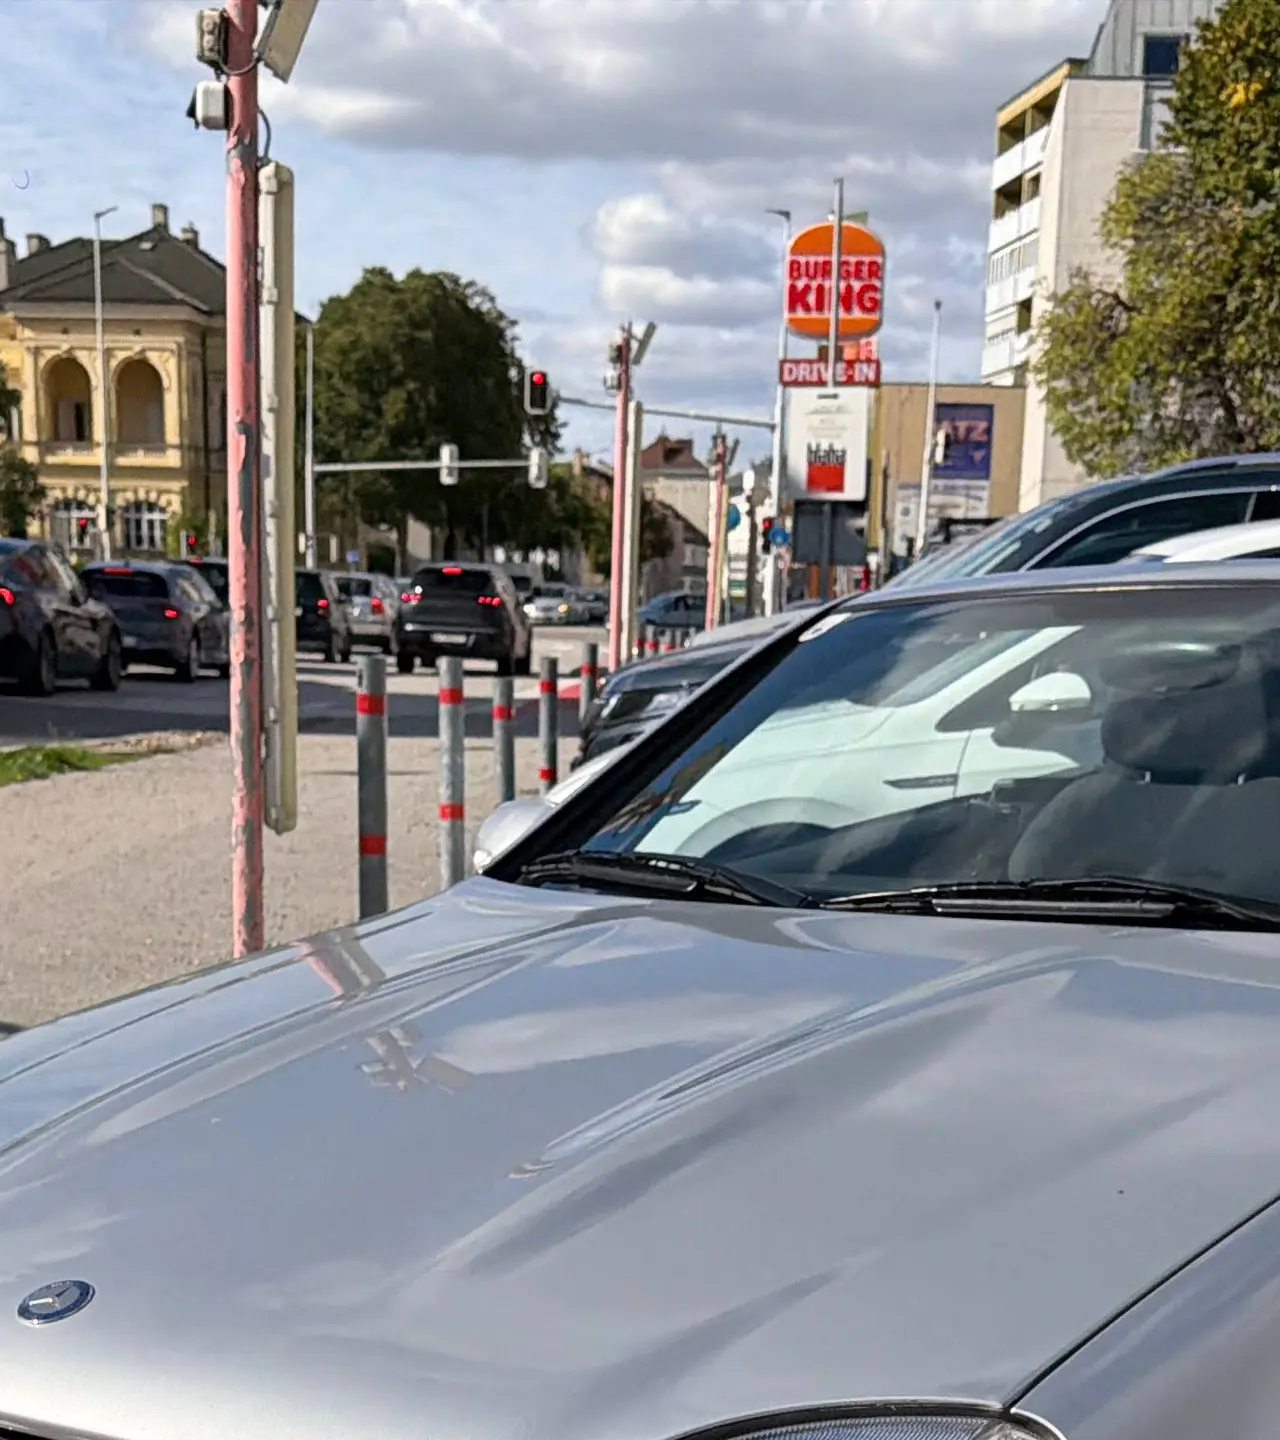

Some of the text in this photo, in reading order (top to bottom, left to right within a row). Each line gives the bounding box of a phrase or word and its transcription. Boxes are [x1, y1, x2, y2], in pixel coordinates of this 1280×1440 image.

[789, 259, 881, 281] BURGER
[787, 283, 880, 314] KING
[782, 362, 877, 383] DRIVE-IN
